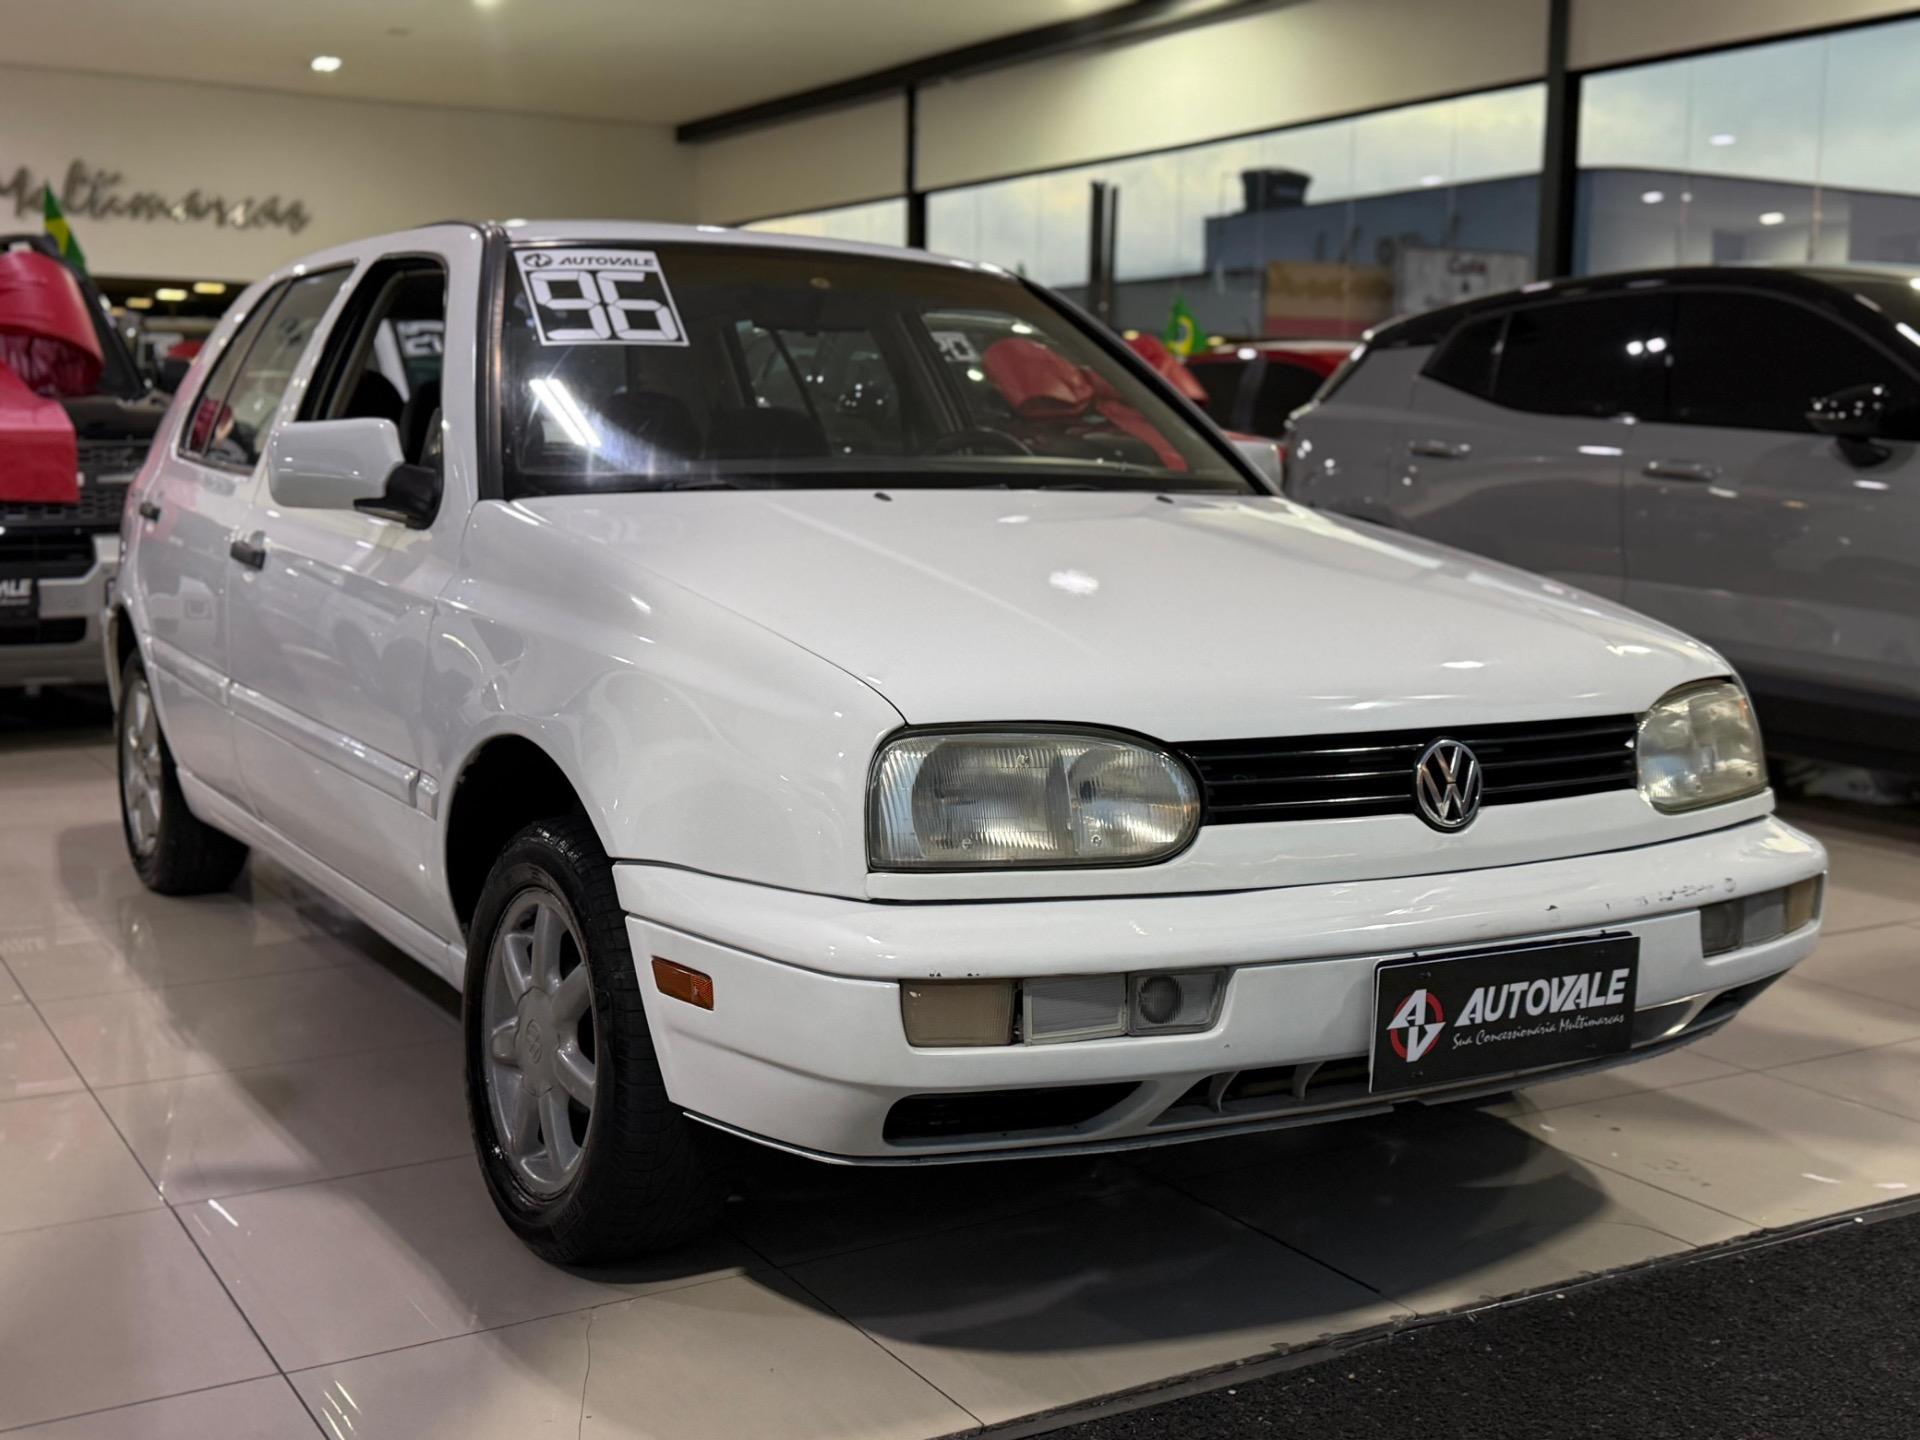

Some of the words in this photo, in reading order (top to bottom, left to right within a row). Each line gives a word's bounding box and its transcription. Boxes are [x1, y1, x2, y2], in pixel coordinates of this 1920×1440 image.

[559, 256, 654, 267] AUTOVALE
[529, 271, 679, 340] 96
[1454, 967, 1630, 1028] AUTOVALE
[1452, 1032, 1473, 1050] Sua
[1559, 1014, 1625, 1033] Multimarcas
